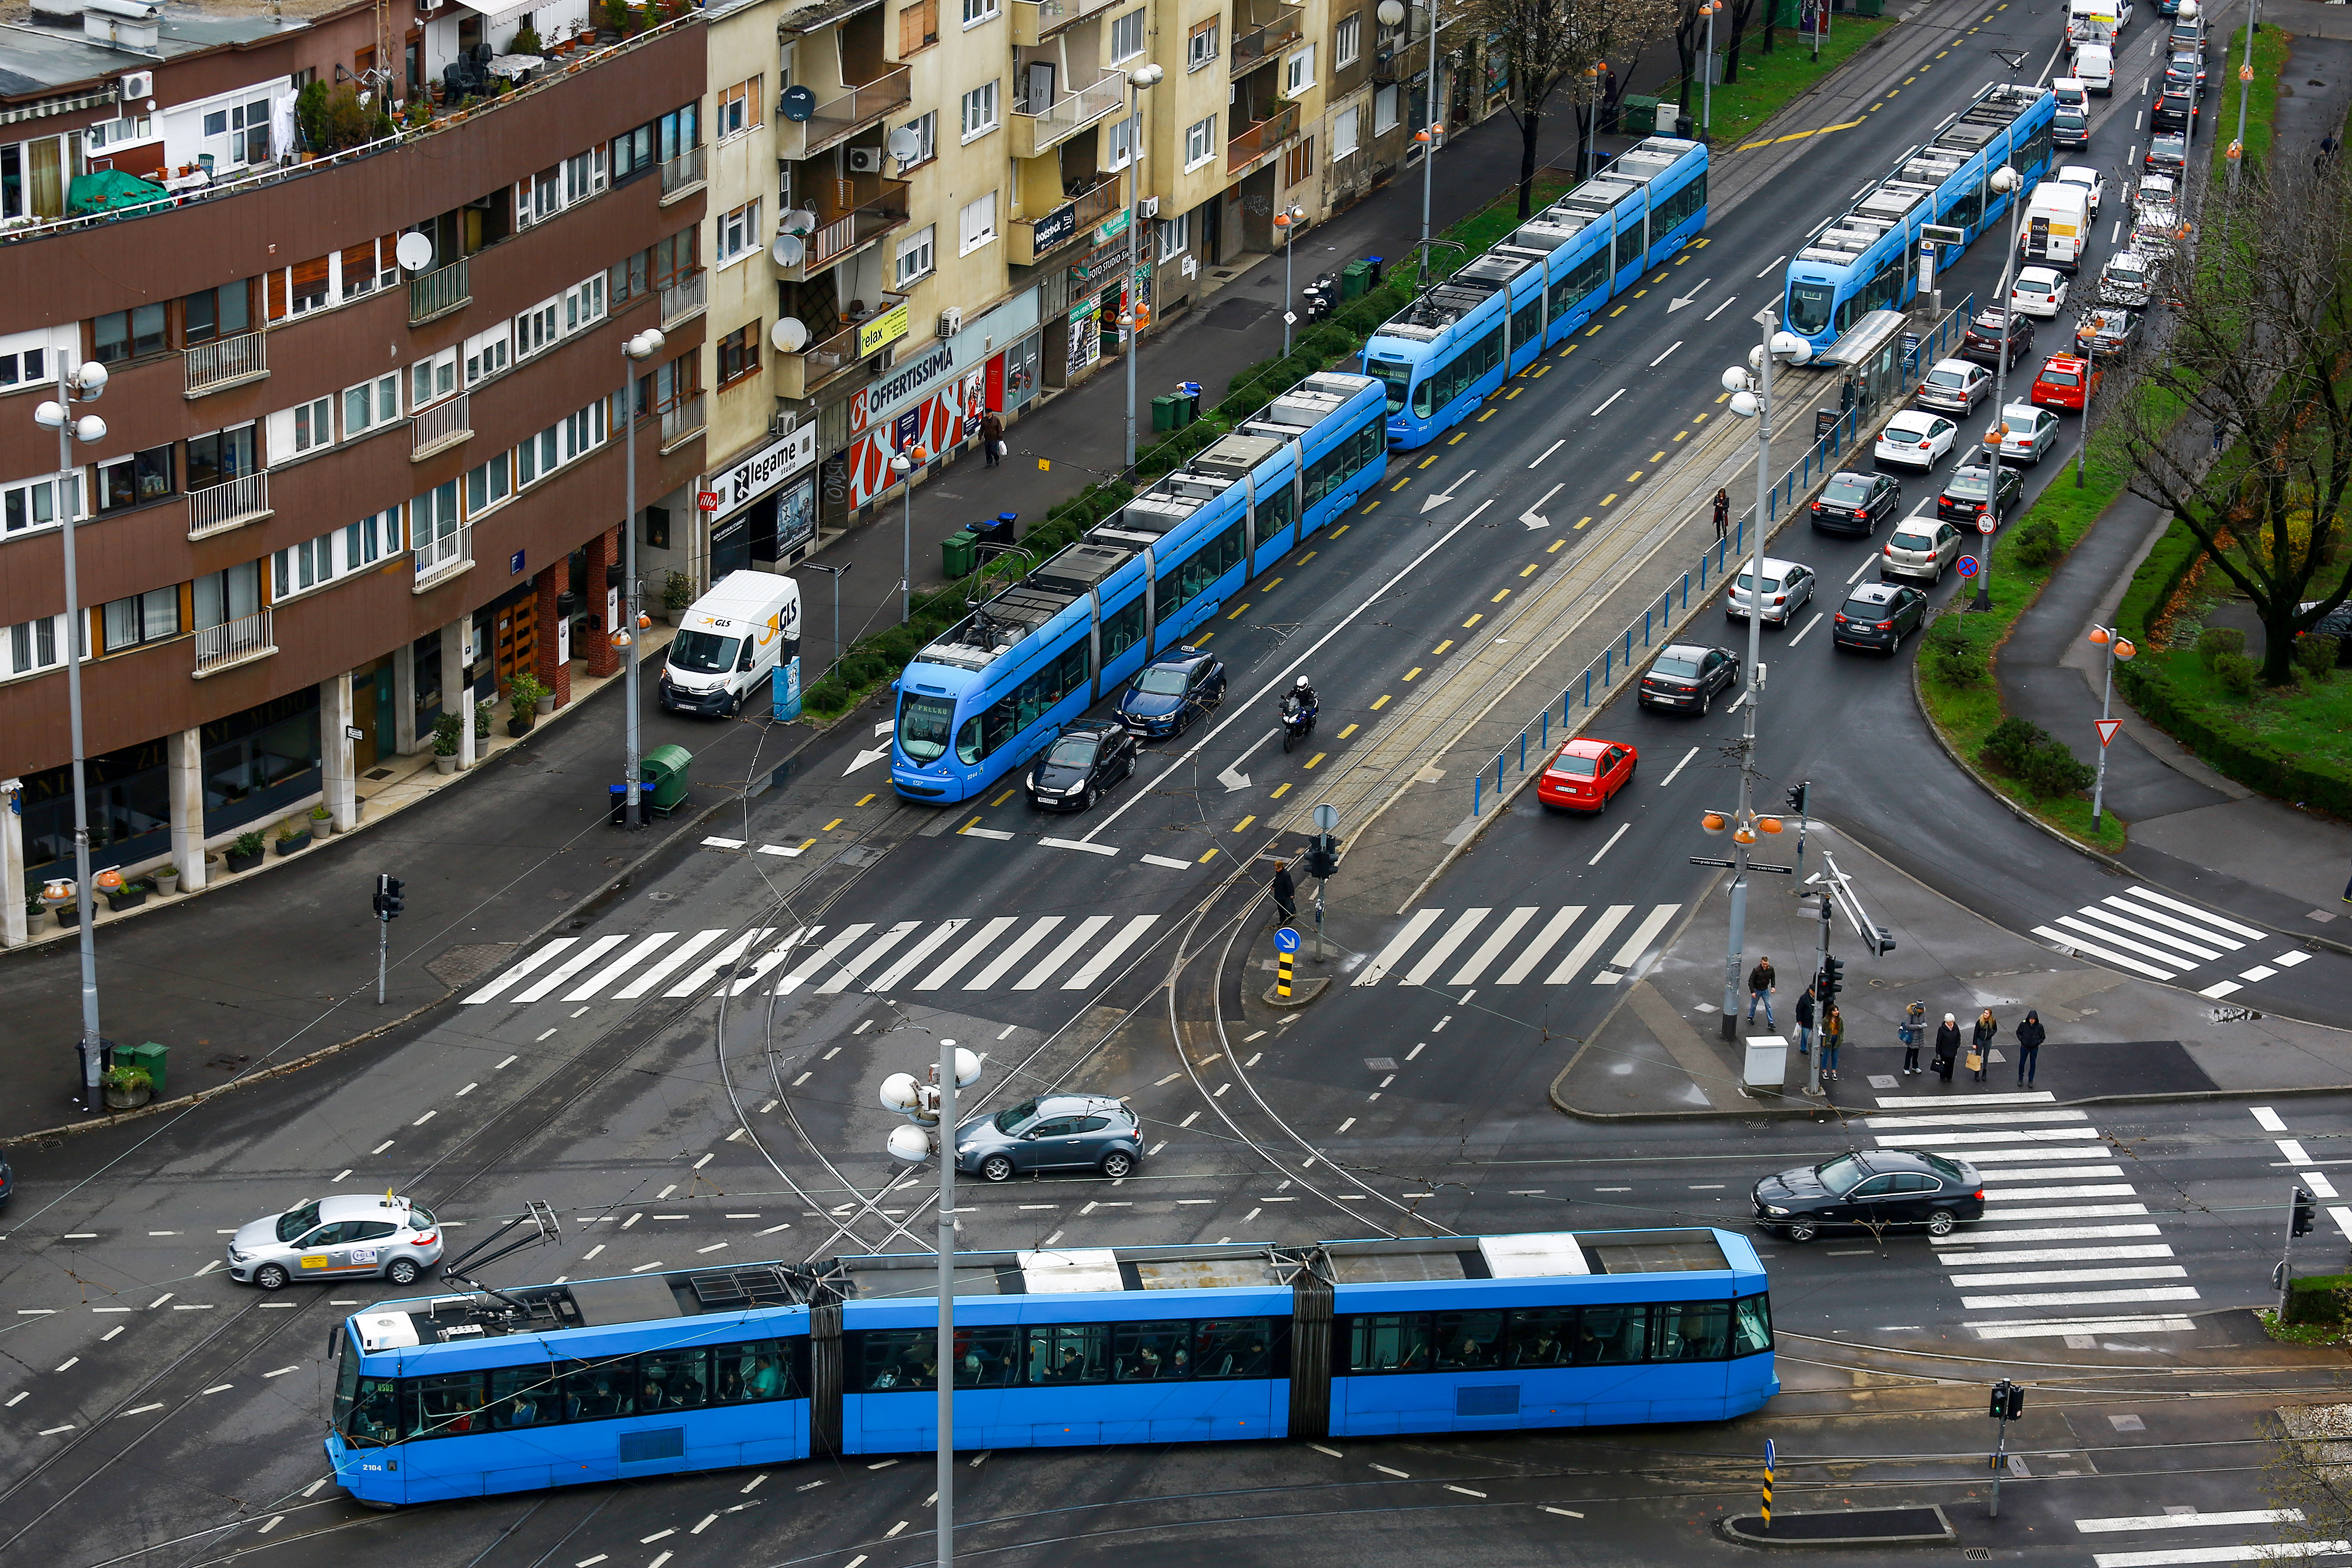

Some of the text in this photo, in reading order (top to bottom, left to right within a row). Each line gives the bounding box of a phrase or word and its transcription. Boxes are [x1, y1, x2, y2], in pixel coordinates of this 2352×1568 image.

[1107, 213, 1124, 230] FUJIFILM
[1035, 220, 1061, 245] foodstock
[1089, 265, 1102, 280] FOTO
[1103, 254, 1120, 272] STUDIO
[1070, 303, 1090, 321] FOTO-VIDEO
[862, 329, 883, 351] relax
[870, 346, 953, 413] OFFERTISSIMA
[751, 442, 796, 484] legame
[781, 462, 796, 475] studio
[700, 495, 716, 509] illy
[715, 619, 732, 627] GLS
[779, 597, 797, 631] GLS
[250, 691, 306, 728] MEDO
[967, 772, 978, 780] 2244
[378, 1383, 393, 1392] 0503
